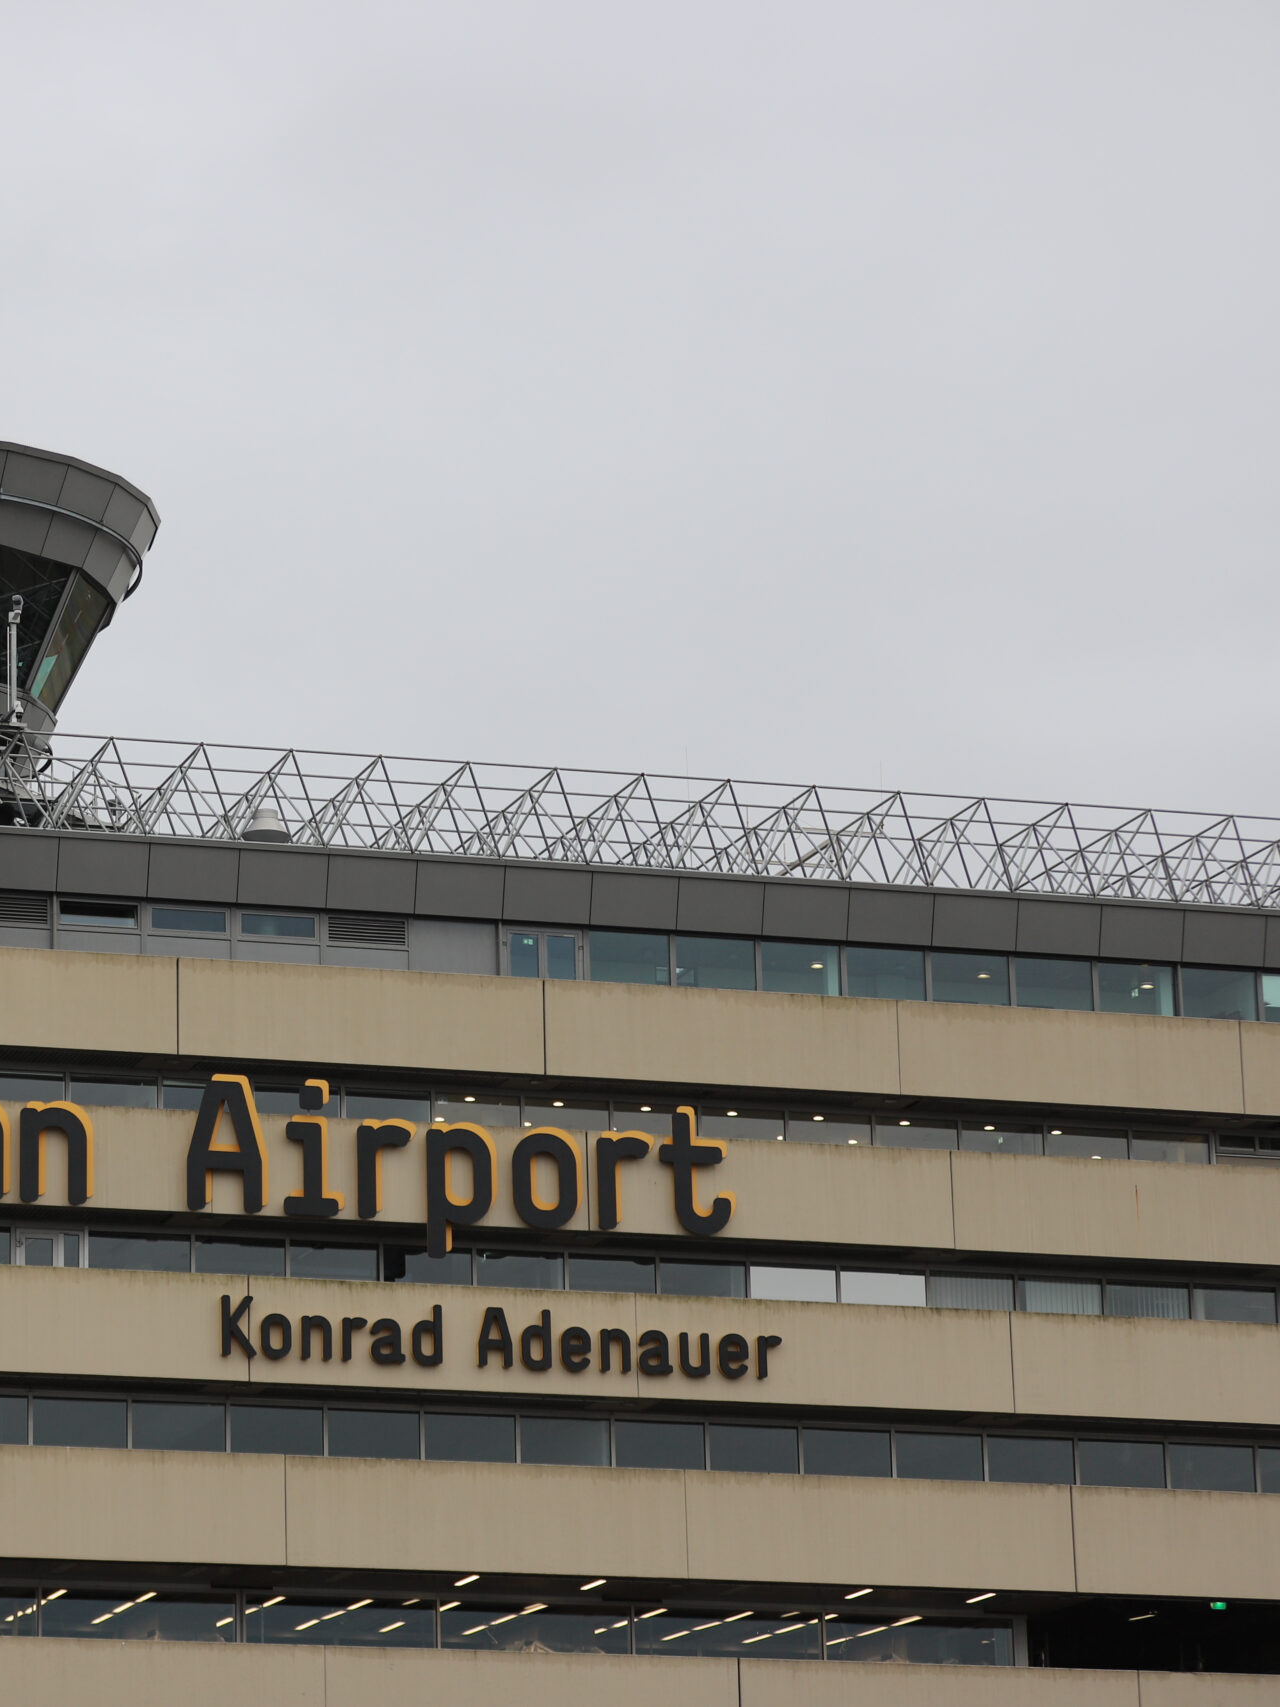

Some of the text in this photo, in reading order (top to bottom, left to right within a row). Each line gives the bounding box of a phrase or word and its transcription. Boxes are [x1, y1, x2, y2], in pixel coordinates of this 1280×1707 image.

[187, 1073, 736, 1259] Airport
[219, 1294, 782, 1379] Konrad Adenauer
